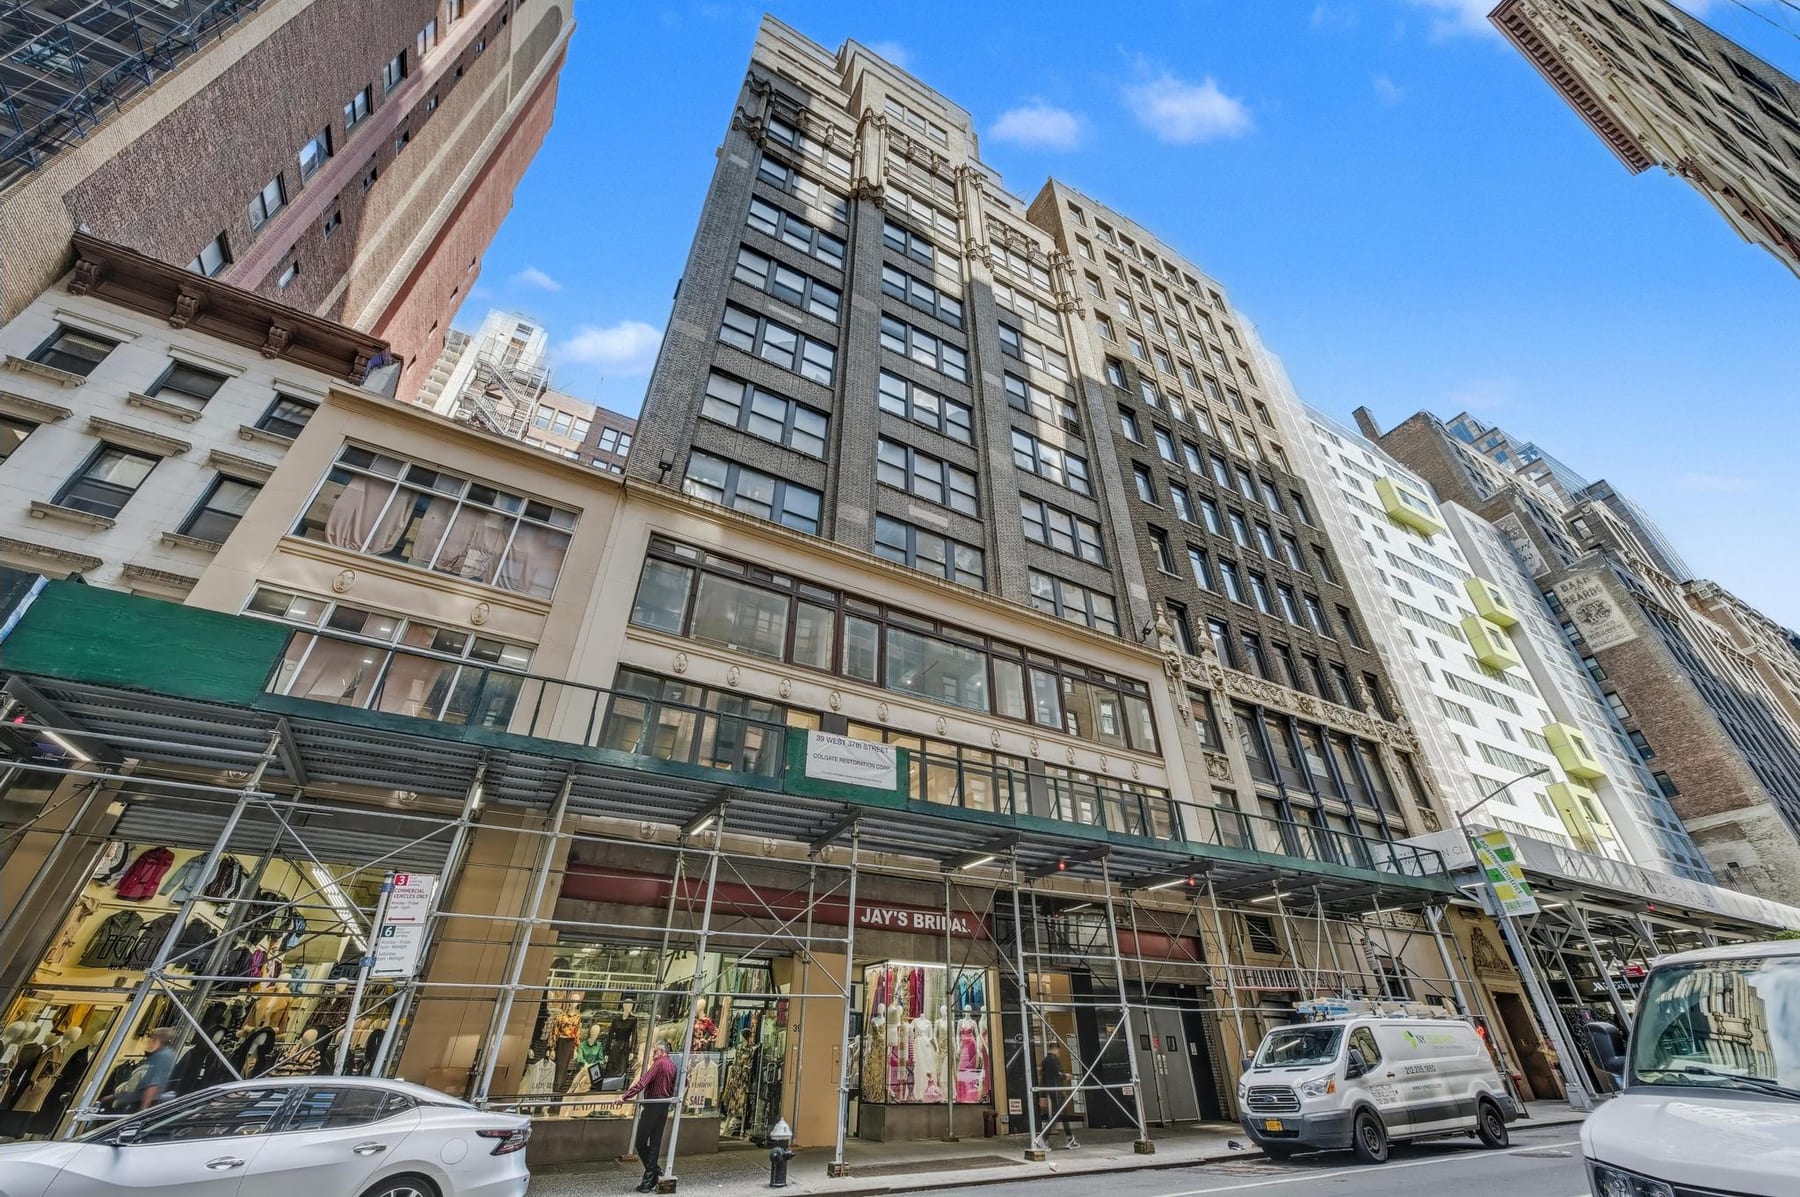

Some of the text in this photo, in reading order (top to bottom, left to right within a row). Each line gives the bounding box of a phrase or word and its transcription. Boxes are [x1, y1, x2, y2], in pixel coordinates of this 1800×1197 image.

[815, 734, 825, 743] 39
[826, 736, 846, 747] WEST
[863, 743, 889, 754] STREET
[839, 757, 876, 769] RESTORATION
[398, 875, 406, 886] 3
[861, 908, 908, 927] JAY'S
[384, 926, 392, 937] 6
[690, 1095, 705, 1106] SALE
